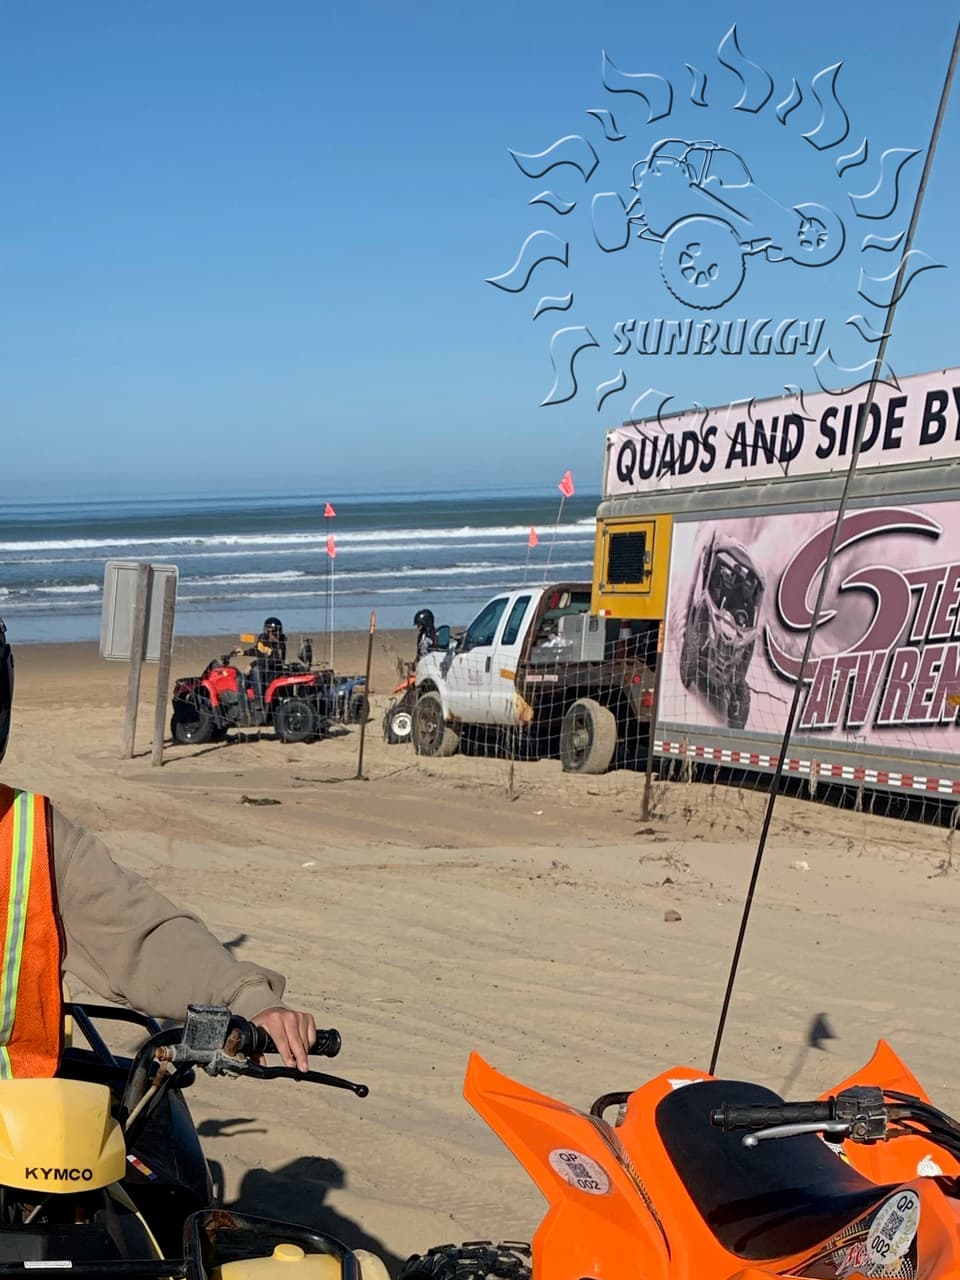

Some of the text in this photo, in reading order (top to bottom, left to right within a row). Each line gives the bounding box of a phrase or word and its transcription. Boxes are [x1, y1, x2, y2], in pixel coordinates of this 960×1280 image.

[616, 426, 718, 484] QUADS
[726, 414, 805, 470] AND
[816, 396, 908, 460] SIDE
[798, 648, 888, 729] ATV
[558, 1153, 578, 1162] QP
[25, 1167, 93, 1181] KYMCO
[577, 1179, 601, 1190] 002
[896, 1195, 914, 1213] QP
[871, 1235, 891, 1258] 002
